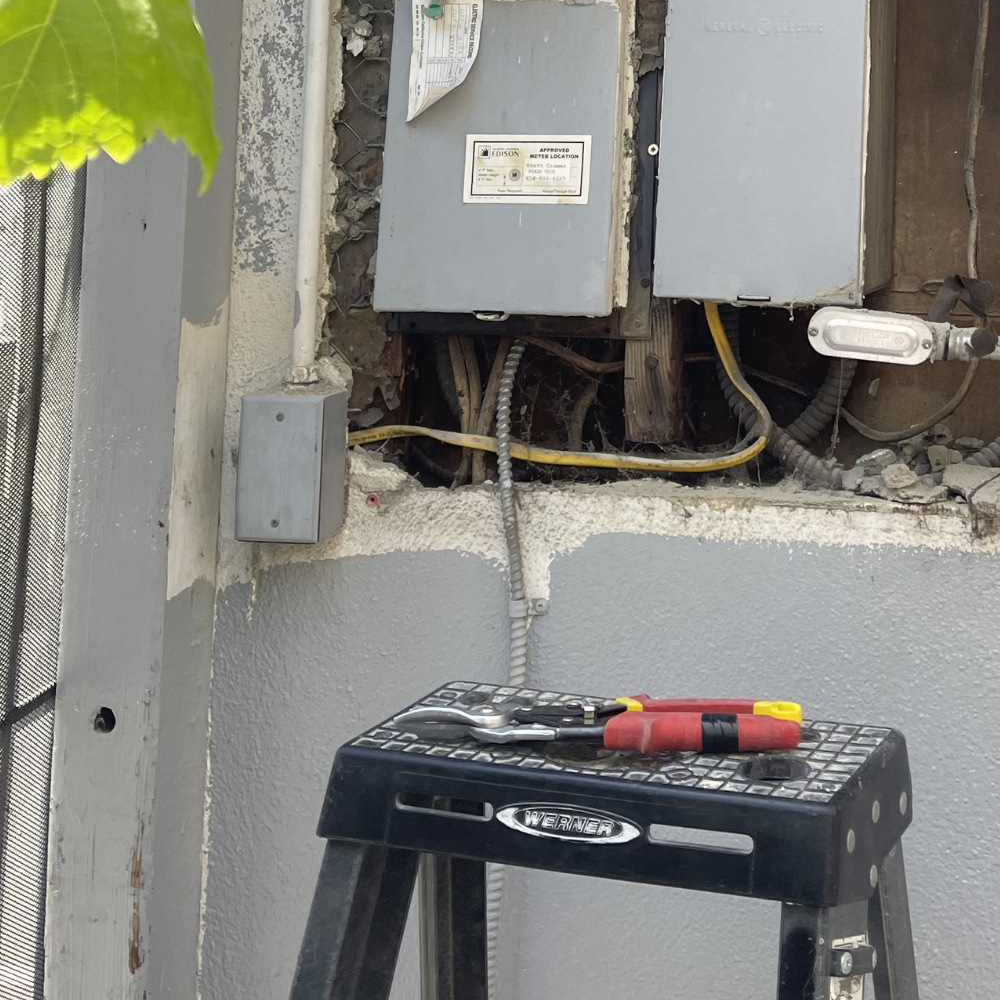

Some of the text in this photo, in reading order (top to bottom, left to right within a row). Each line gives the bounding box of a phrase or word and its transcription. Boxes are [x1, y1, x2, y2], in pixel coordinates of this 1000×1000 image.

[471, 3, 479, 23] ELECTRIC
[492, 150, 521, 158] EDISON
[524, 810, 615, 836] WERNER
